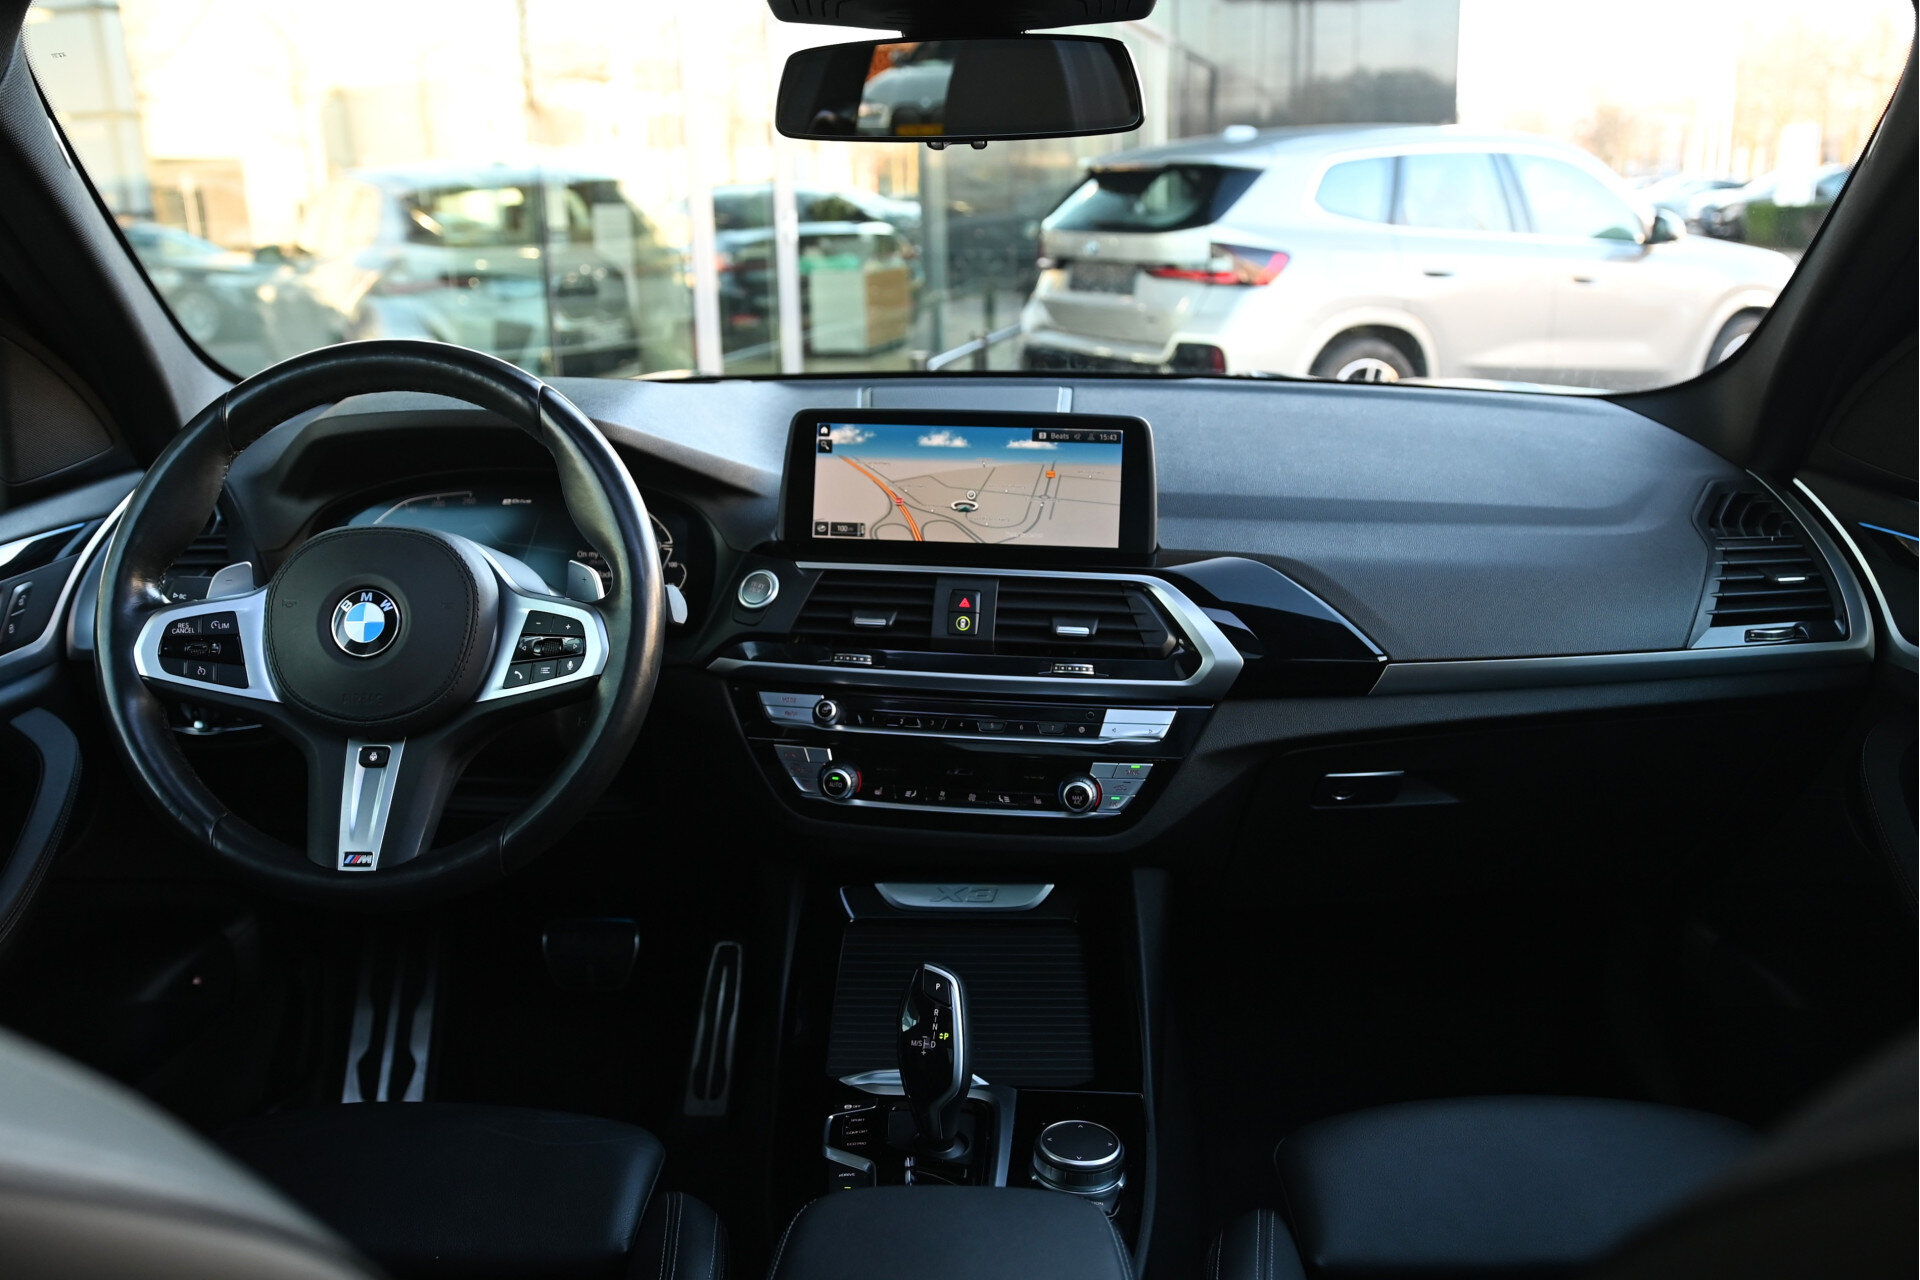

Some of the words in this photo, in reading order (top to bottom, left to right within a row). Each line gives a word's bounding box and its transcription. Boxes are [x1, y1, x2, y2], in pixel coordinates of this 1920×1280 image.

[1050, 432, 1070, 440] Beats
[1099, 433, 1117, 441] 15:43
[340, 591, 394, 612] BMW
[171, 627, 195, 635] CANCEL
[929, 886, 998, 903] X3
[935, 982, 941, 990] P
[933, 1008, 939, 1016] R
[932, 1023, 938, 1031] N
[910, 1039, 923, 1047] M/S
[930, 1040, 937, 1048] D
